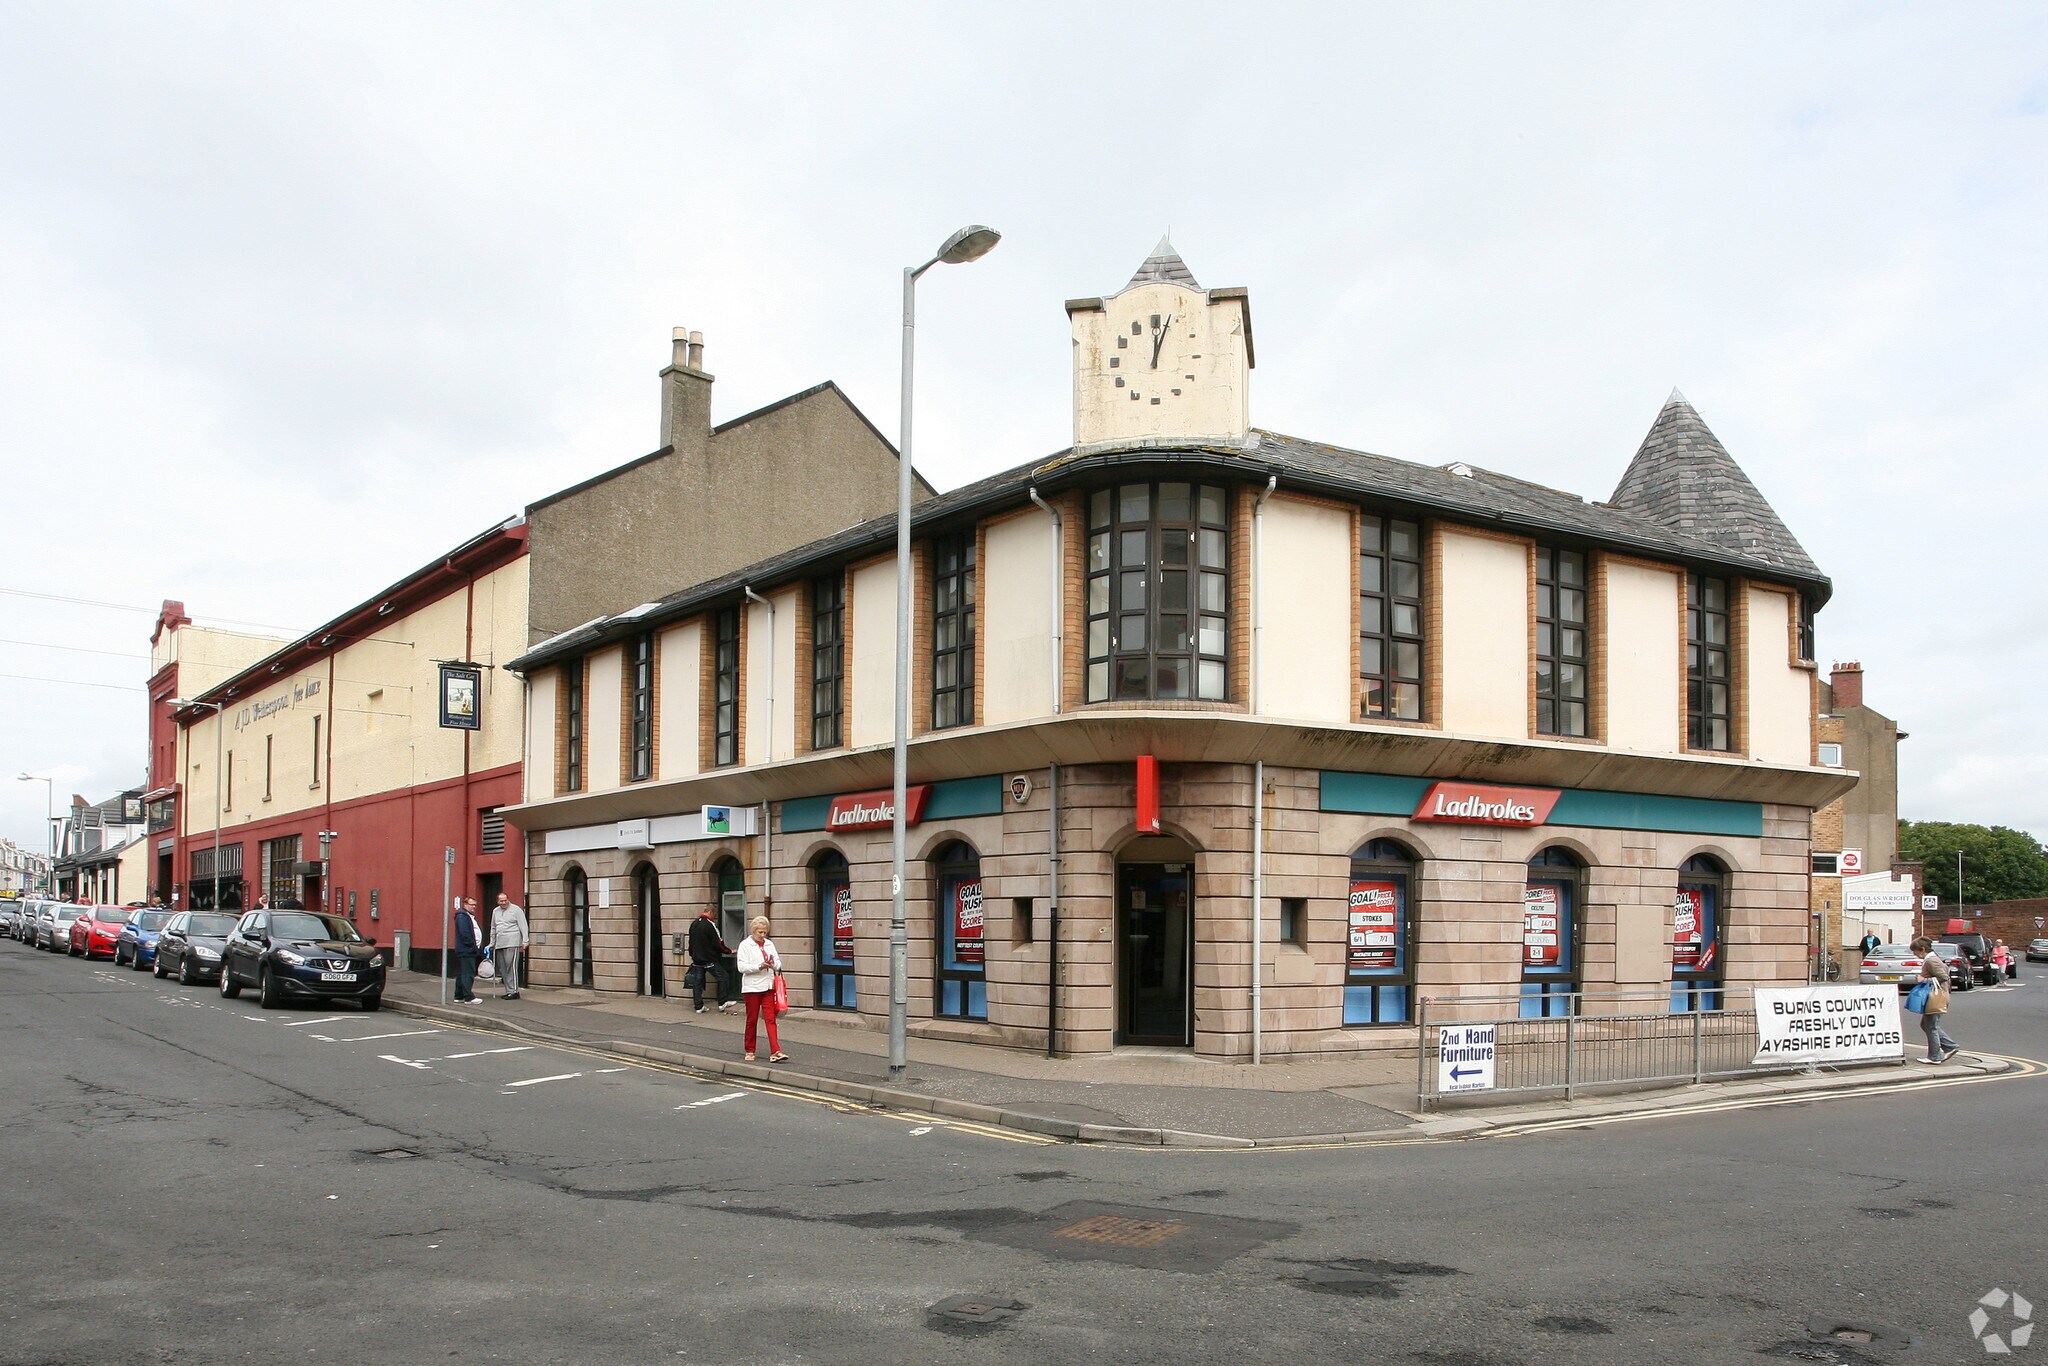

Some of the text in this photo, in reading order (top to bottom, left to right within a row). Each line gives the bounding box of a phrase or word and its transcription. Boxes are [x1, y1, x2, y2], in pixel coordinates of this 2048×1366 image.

[831, 801, 895, 826] Ladbroke
[1433, 793, 1535, 821] Ladbrokes
[838, 890, 851, 902] GOA
[960, 885, 981, 899] GOAL
[1350, 891, 1377, 905] GOAL!
[1676, 893, 1690, 905] OAL
[1675, 921, 1694, 932] CORE?
[1773, 997, 1885, 1015] BURNS COUNTRY
[1788, 1015, 1876, 1033] FRESHLY DUG
[1441, 1027, 1494, 1046] 2nd Hand
[1760, 1031, 1900, 1053] AYRSHIRE POTATOES
[1440, 1045, 1493, 1063] Furniture
